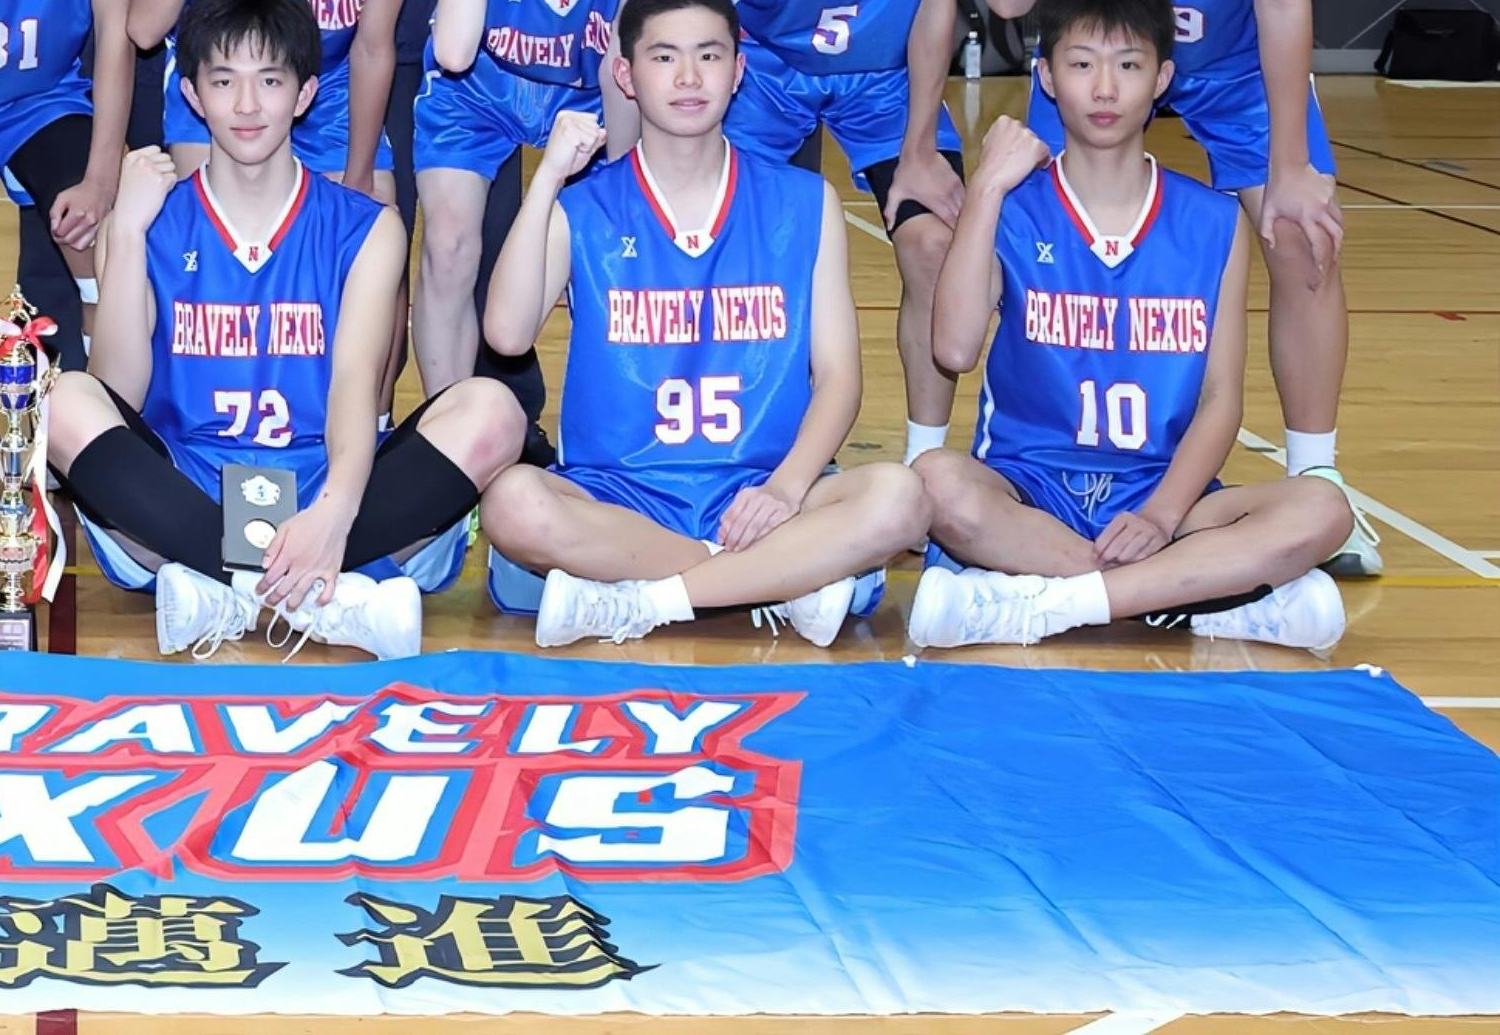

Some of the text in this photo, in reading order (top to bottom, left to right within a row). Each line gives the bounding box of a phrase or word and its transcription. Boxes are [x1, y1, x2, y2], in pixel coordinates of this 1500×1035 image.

[812, 5, 859, 55] 5
[172, 300, 326, 357] BRAVELY NEXUS
[607, 284, 787, 344] BRAVELY NEXUS
[1025, 288, 1208, 353] BRAVELY NEXUS
[213, 389, 294, 448] 72
[654, 375, 742, 445] 95
[1076, 379, 1148, 450] 10
